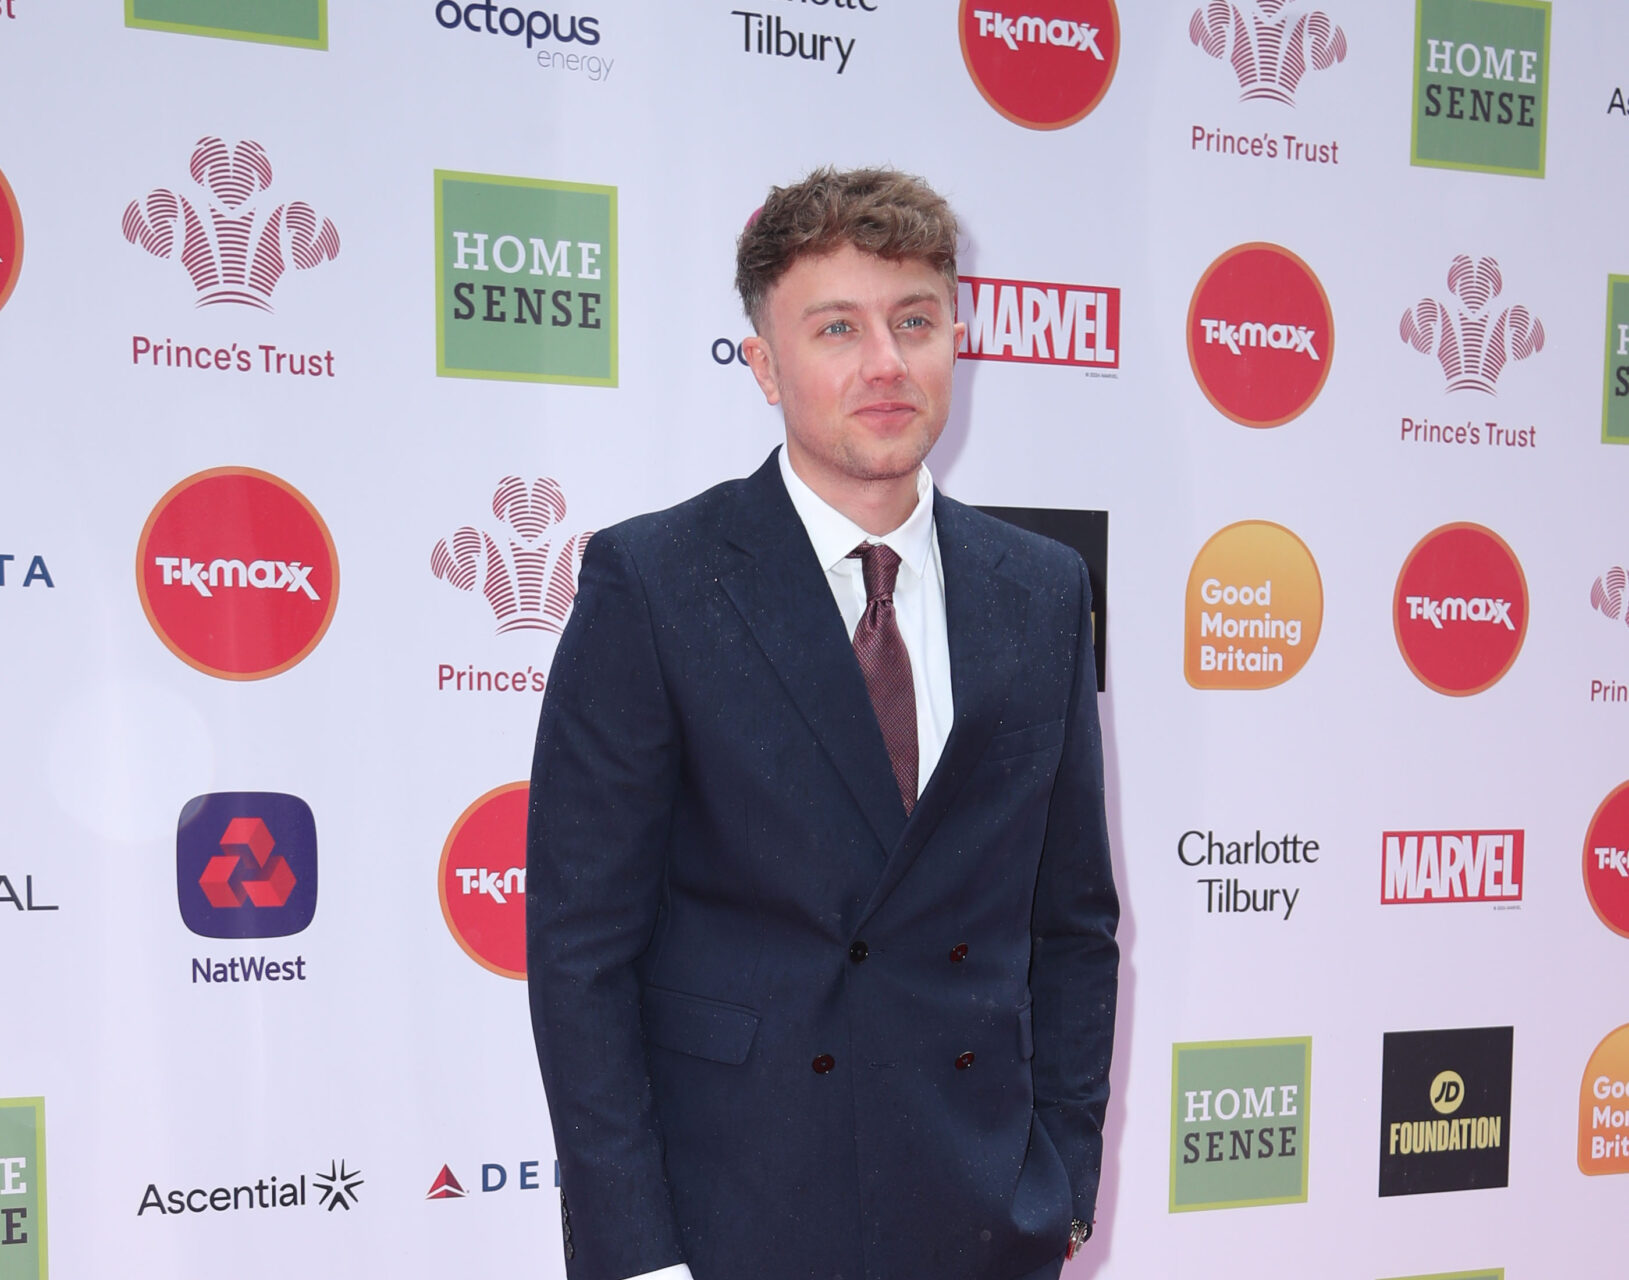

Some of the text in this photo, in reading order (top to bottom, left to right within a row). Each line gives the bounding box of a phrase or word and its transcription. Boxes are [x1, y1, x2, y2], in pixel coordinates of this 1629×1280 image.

[435, 0, 600, 49] octopus
[731, 10, 856, 74] Tilbury
[537, 51, 613, 81] energy
[1427, 39, 1537, 83] HOME
[1425, 84, 1535, 127] SENSE
[1192, 126, 1338, 164] Prince's Trust
[453, 232, 601, 280] HOME
[454, 282, 600, 329] SENSE
[958, 282, 1115, 363] MARVEL
[133, 336, 335, 377] Prince's Trust
[1401, 418, 1536, 448] Prince's Trust
[1201, 579, 1271, 605] Good
[1201, 611, 1301, 645] Morning
[1201, 645, 1283, 672] Britain
[439, 664, 545, 692] Prince's
[1177, 830, 1320, 866] Charlotte
[1384, 834, 1519, 899] MARVEL
[1197, 878, 1300, 920] Tilbury
[192, 955, 306, 983] NatWest
[1184, 1086, 1297, 1122] HOME
[1434, 1081, 1460, 1103] JD
[1184, 1126, 1296, 1164] SENSE
[1389, 1116, 1501, 1155] FOUNDATION
[137, 1175, 305, 1216] Ascential
[482, 1160, 560, 1193] DE
